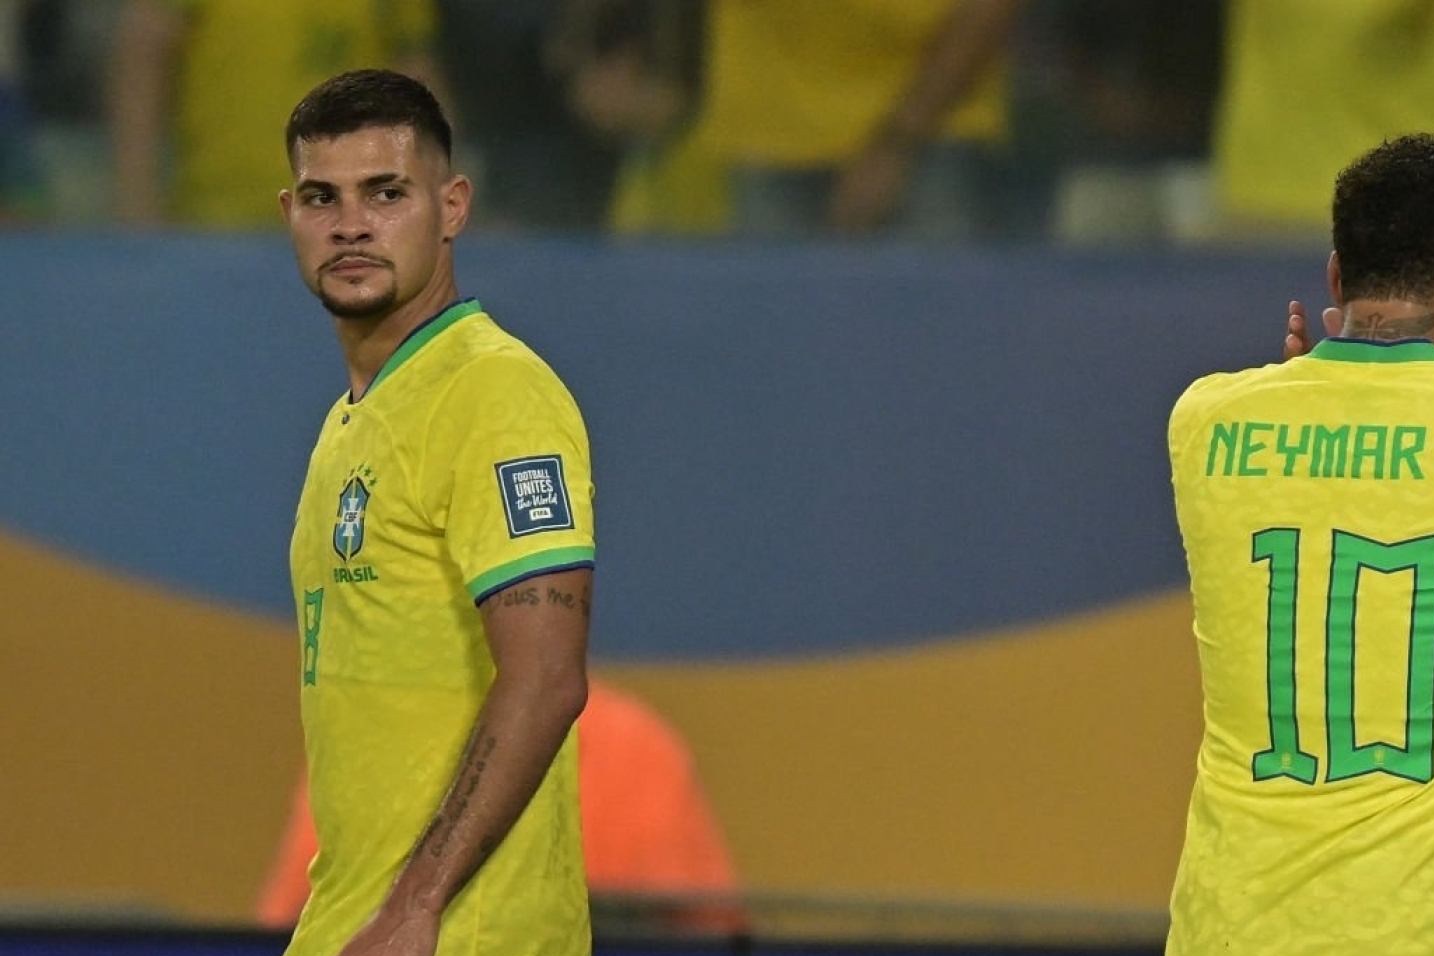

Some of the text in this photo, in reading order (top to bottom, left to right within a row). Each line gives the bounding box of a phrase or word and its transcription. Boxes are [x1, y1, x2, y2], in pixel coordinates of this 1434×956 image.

[1205, 421, 1427, 480] NEYMAR
[512, 469, 550, 483] FOOTBALL
[515, 479, 553, 497] UNITES
[516, 492, 558, 510] the World
[333, 566, 379, 583] BRASIL
[303, 586, 325, 687] 8
